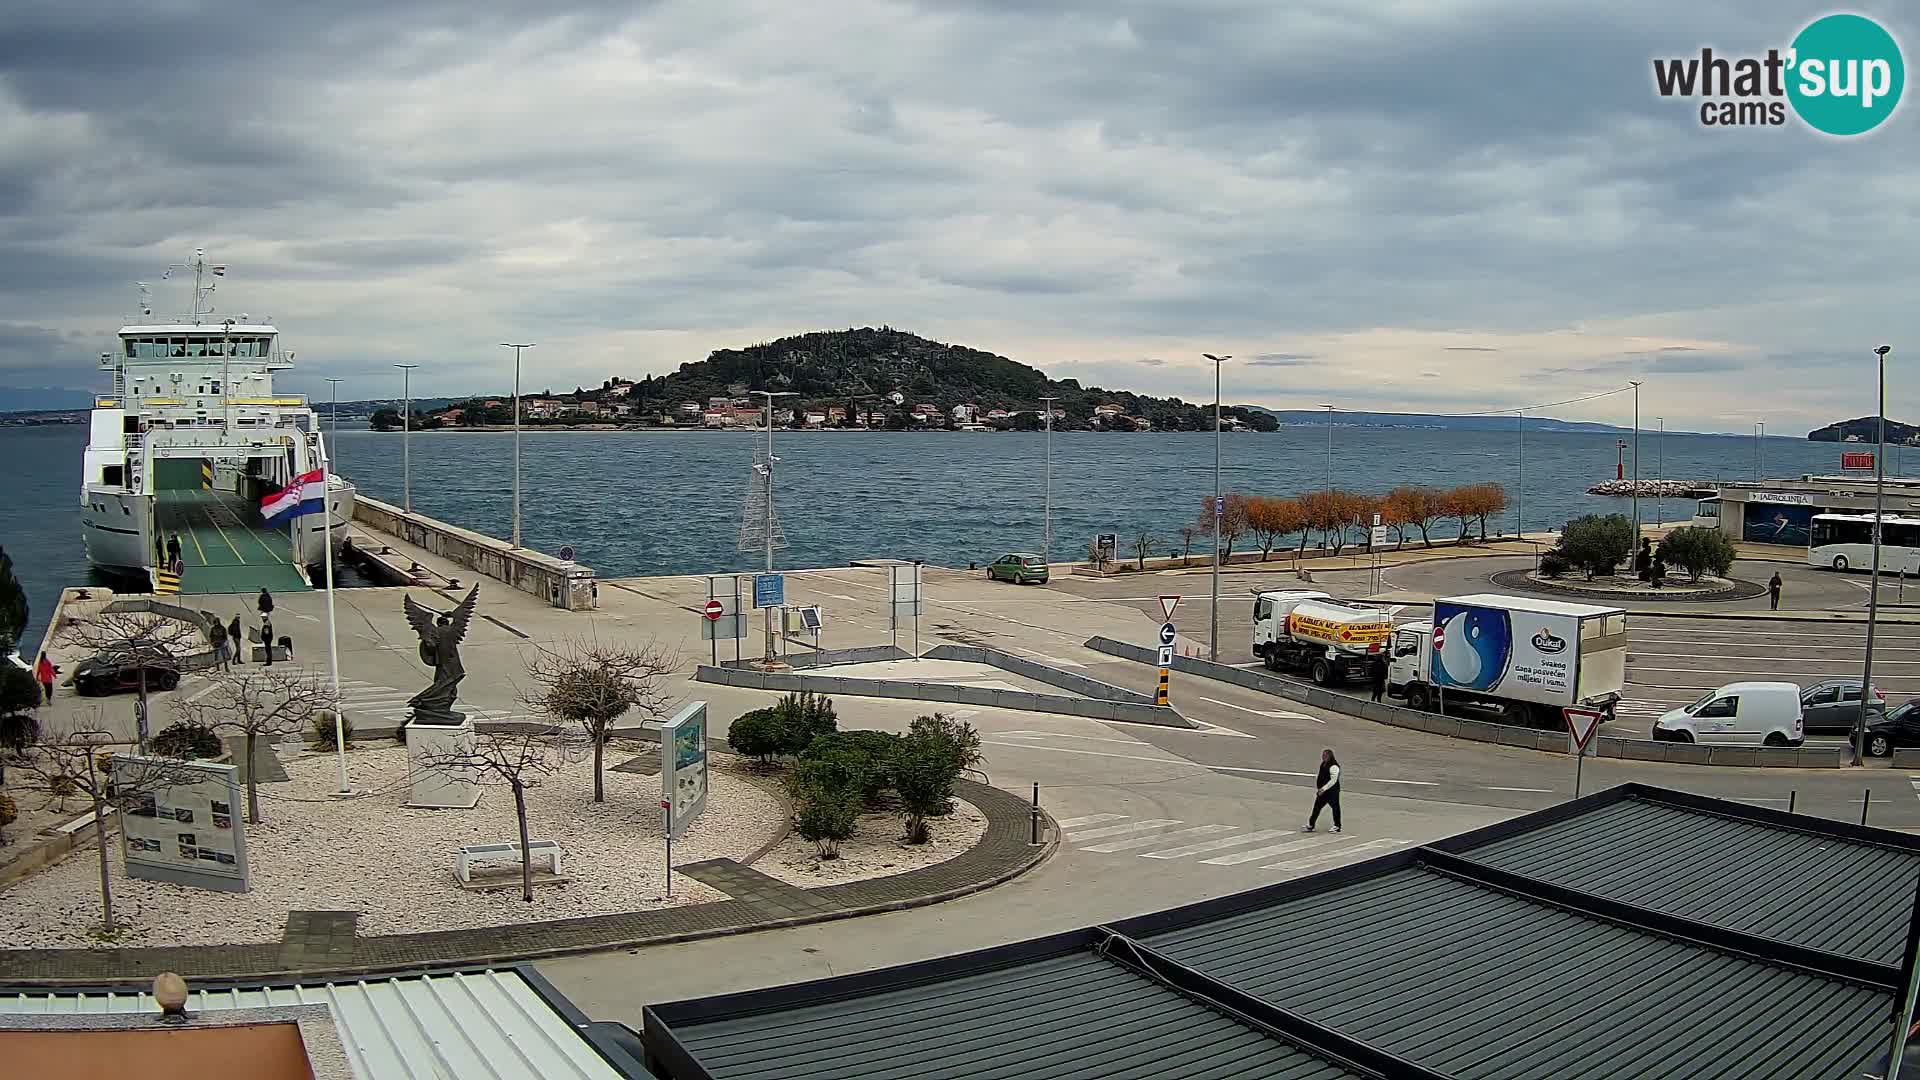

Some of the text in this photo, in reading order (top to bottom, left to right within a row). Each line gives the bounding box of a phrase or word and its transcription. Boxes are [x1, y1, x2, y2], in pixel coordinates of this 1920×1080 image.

[1535, 637, 1561, 648] Dukat
[1515, 665, 1532, 673] dana
[1541, 659, 1567, 670] Svakog
